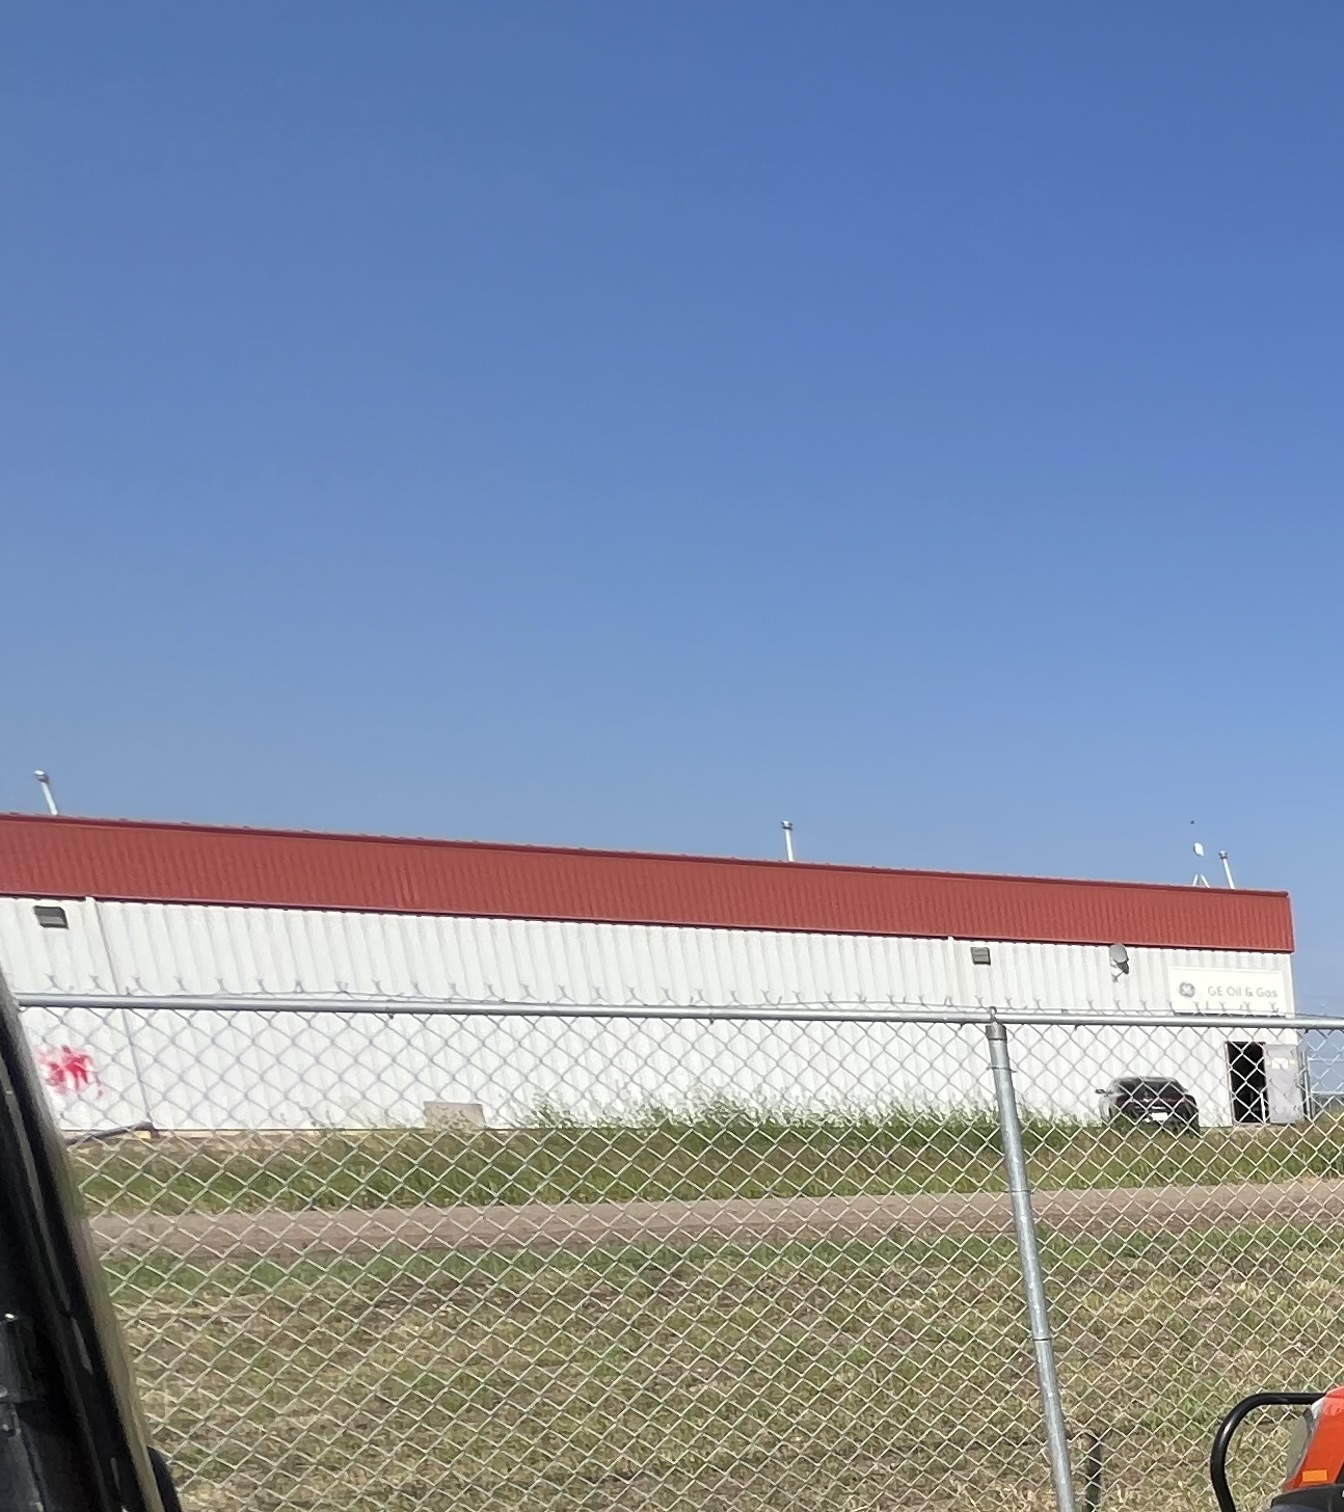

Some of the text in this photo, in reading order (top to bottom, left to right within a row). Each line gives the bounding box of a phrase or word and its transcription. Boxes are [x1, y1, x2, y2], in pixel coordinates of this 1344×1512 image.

[1207, 985, 1224, 997] GE
[1226, 985, 1242, 997] Oil
[1245, 986, 1254, 997] &
[1256, 987, 1278, 998] Gas
